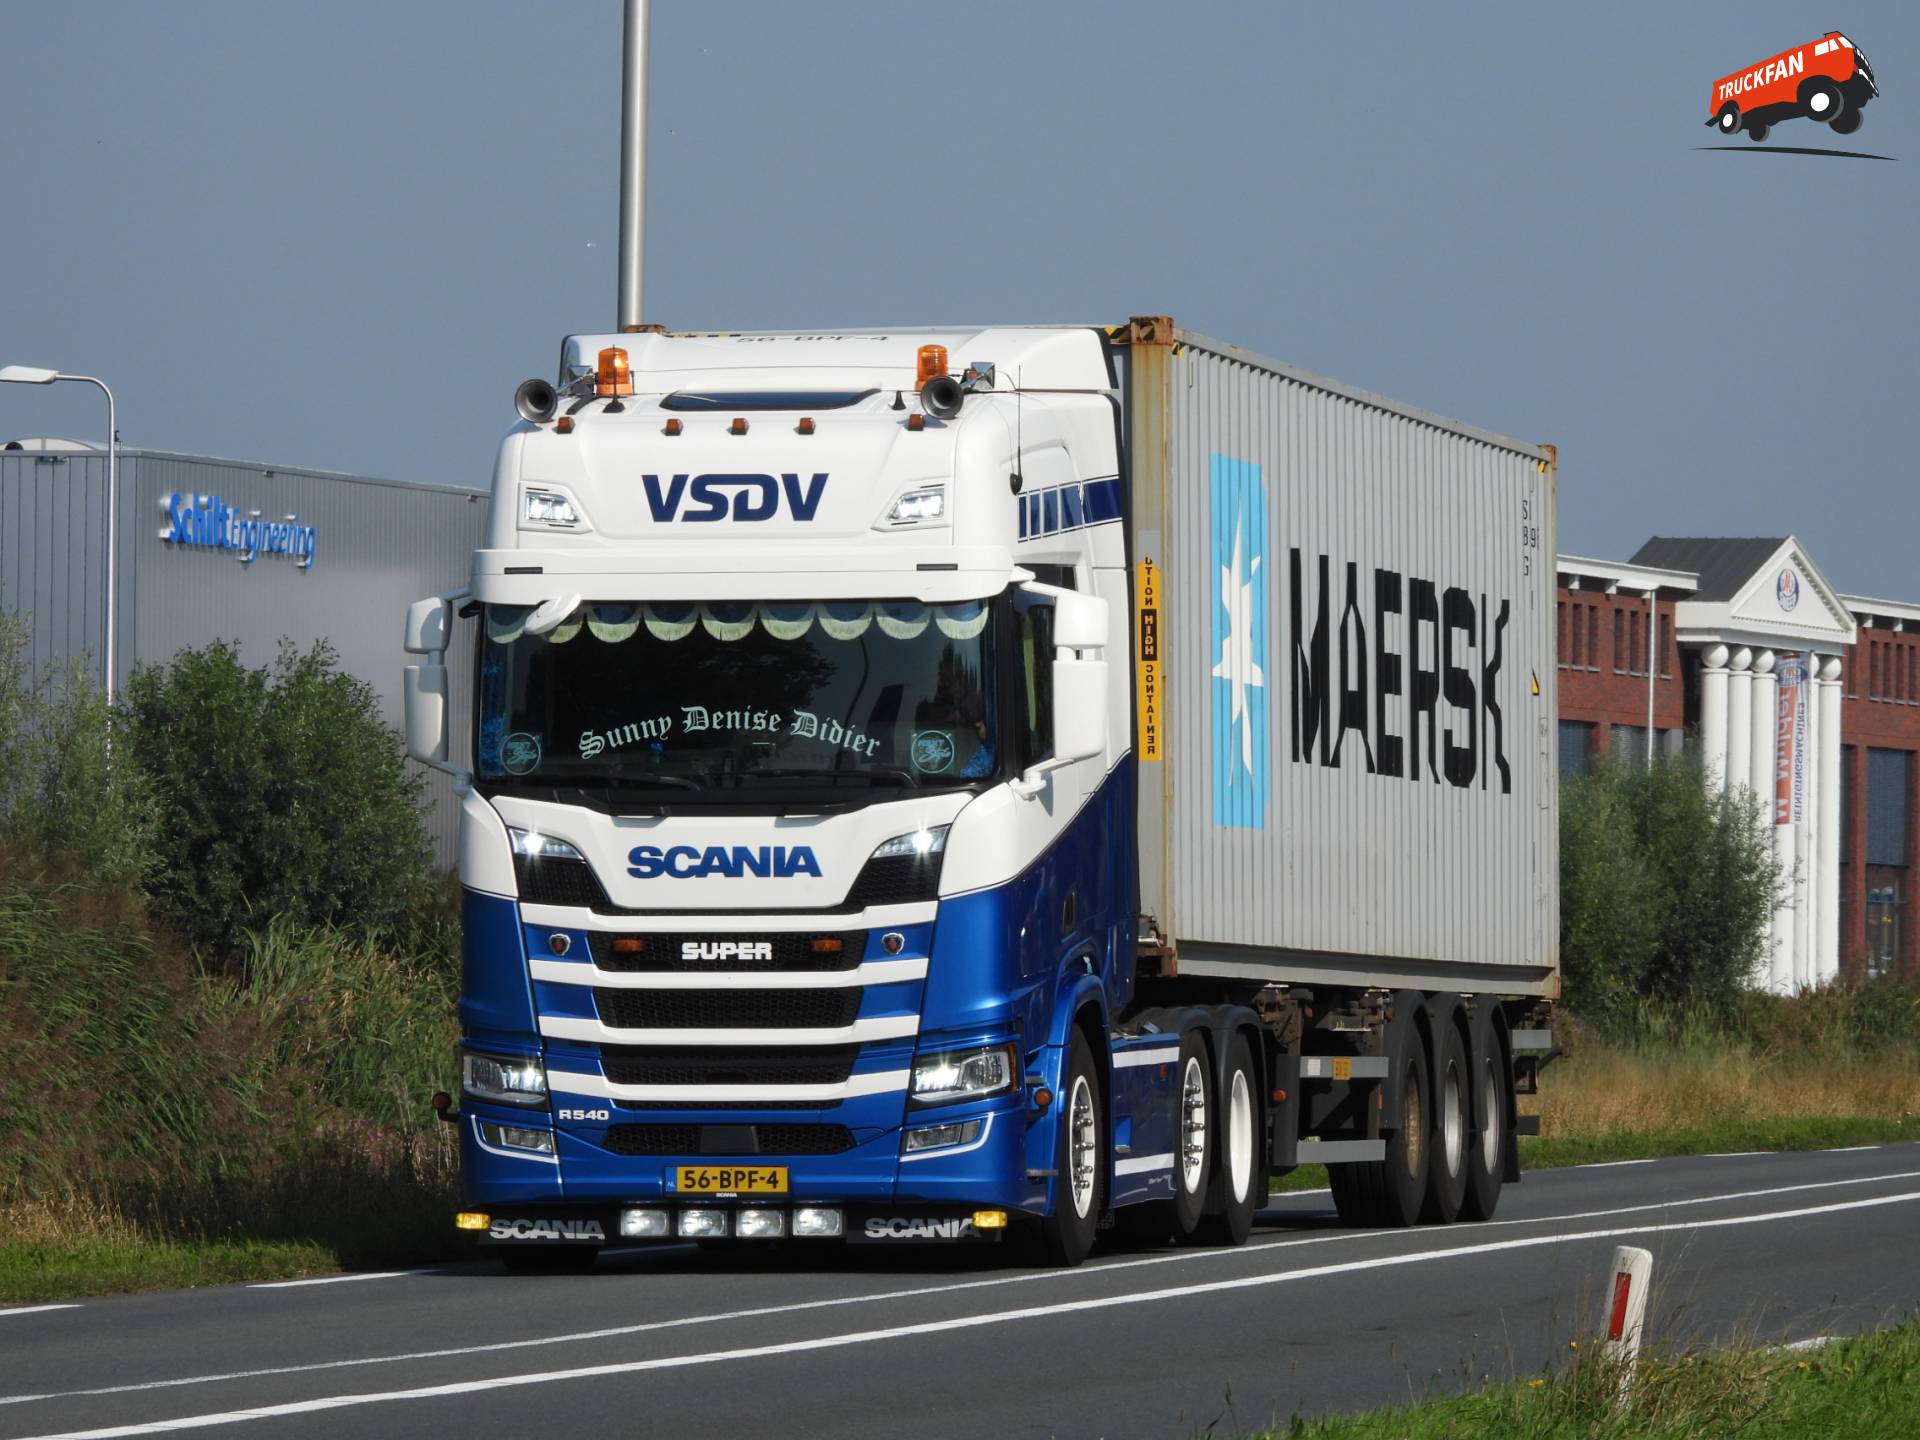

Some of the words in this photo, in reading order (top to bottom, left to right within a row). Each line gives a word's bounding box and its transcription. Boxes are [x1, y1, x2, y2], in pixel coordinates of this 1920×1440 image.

[641, 473, 829, 522] VSDV
[166, 492, 230, 547] Schilt
[230, 506, 317, 569] Engineering
[1290, 547, 1511, 795] MAERSK
[578, 715, 672, 760] Sunny
[681, 705, 782, 734] Denise
[790, 709, 881, 757] Didier
[626, 846, 823, 879] SCANIA
[681, 942, 773, 961] SUPER
[559, 1110, 609, 1120] R540
[684, 1170, 779, 1189] 56-BPF-4
[489, 1219, 606, 1240] SCANIA
[864, 1218, 982, 1238] SCANIA
